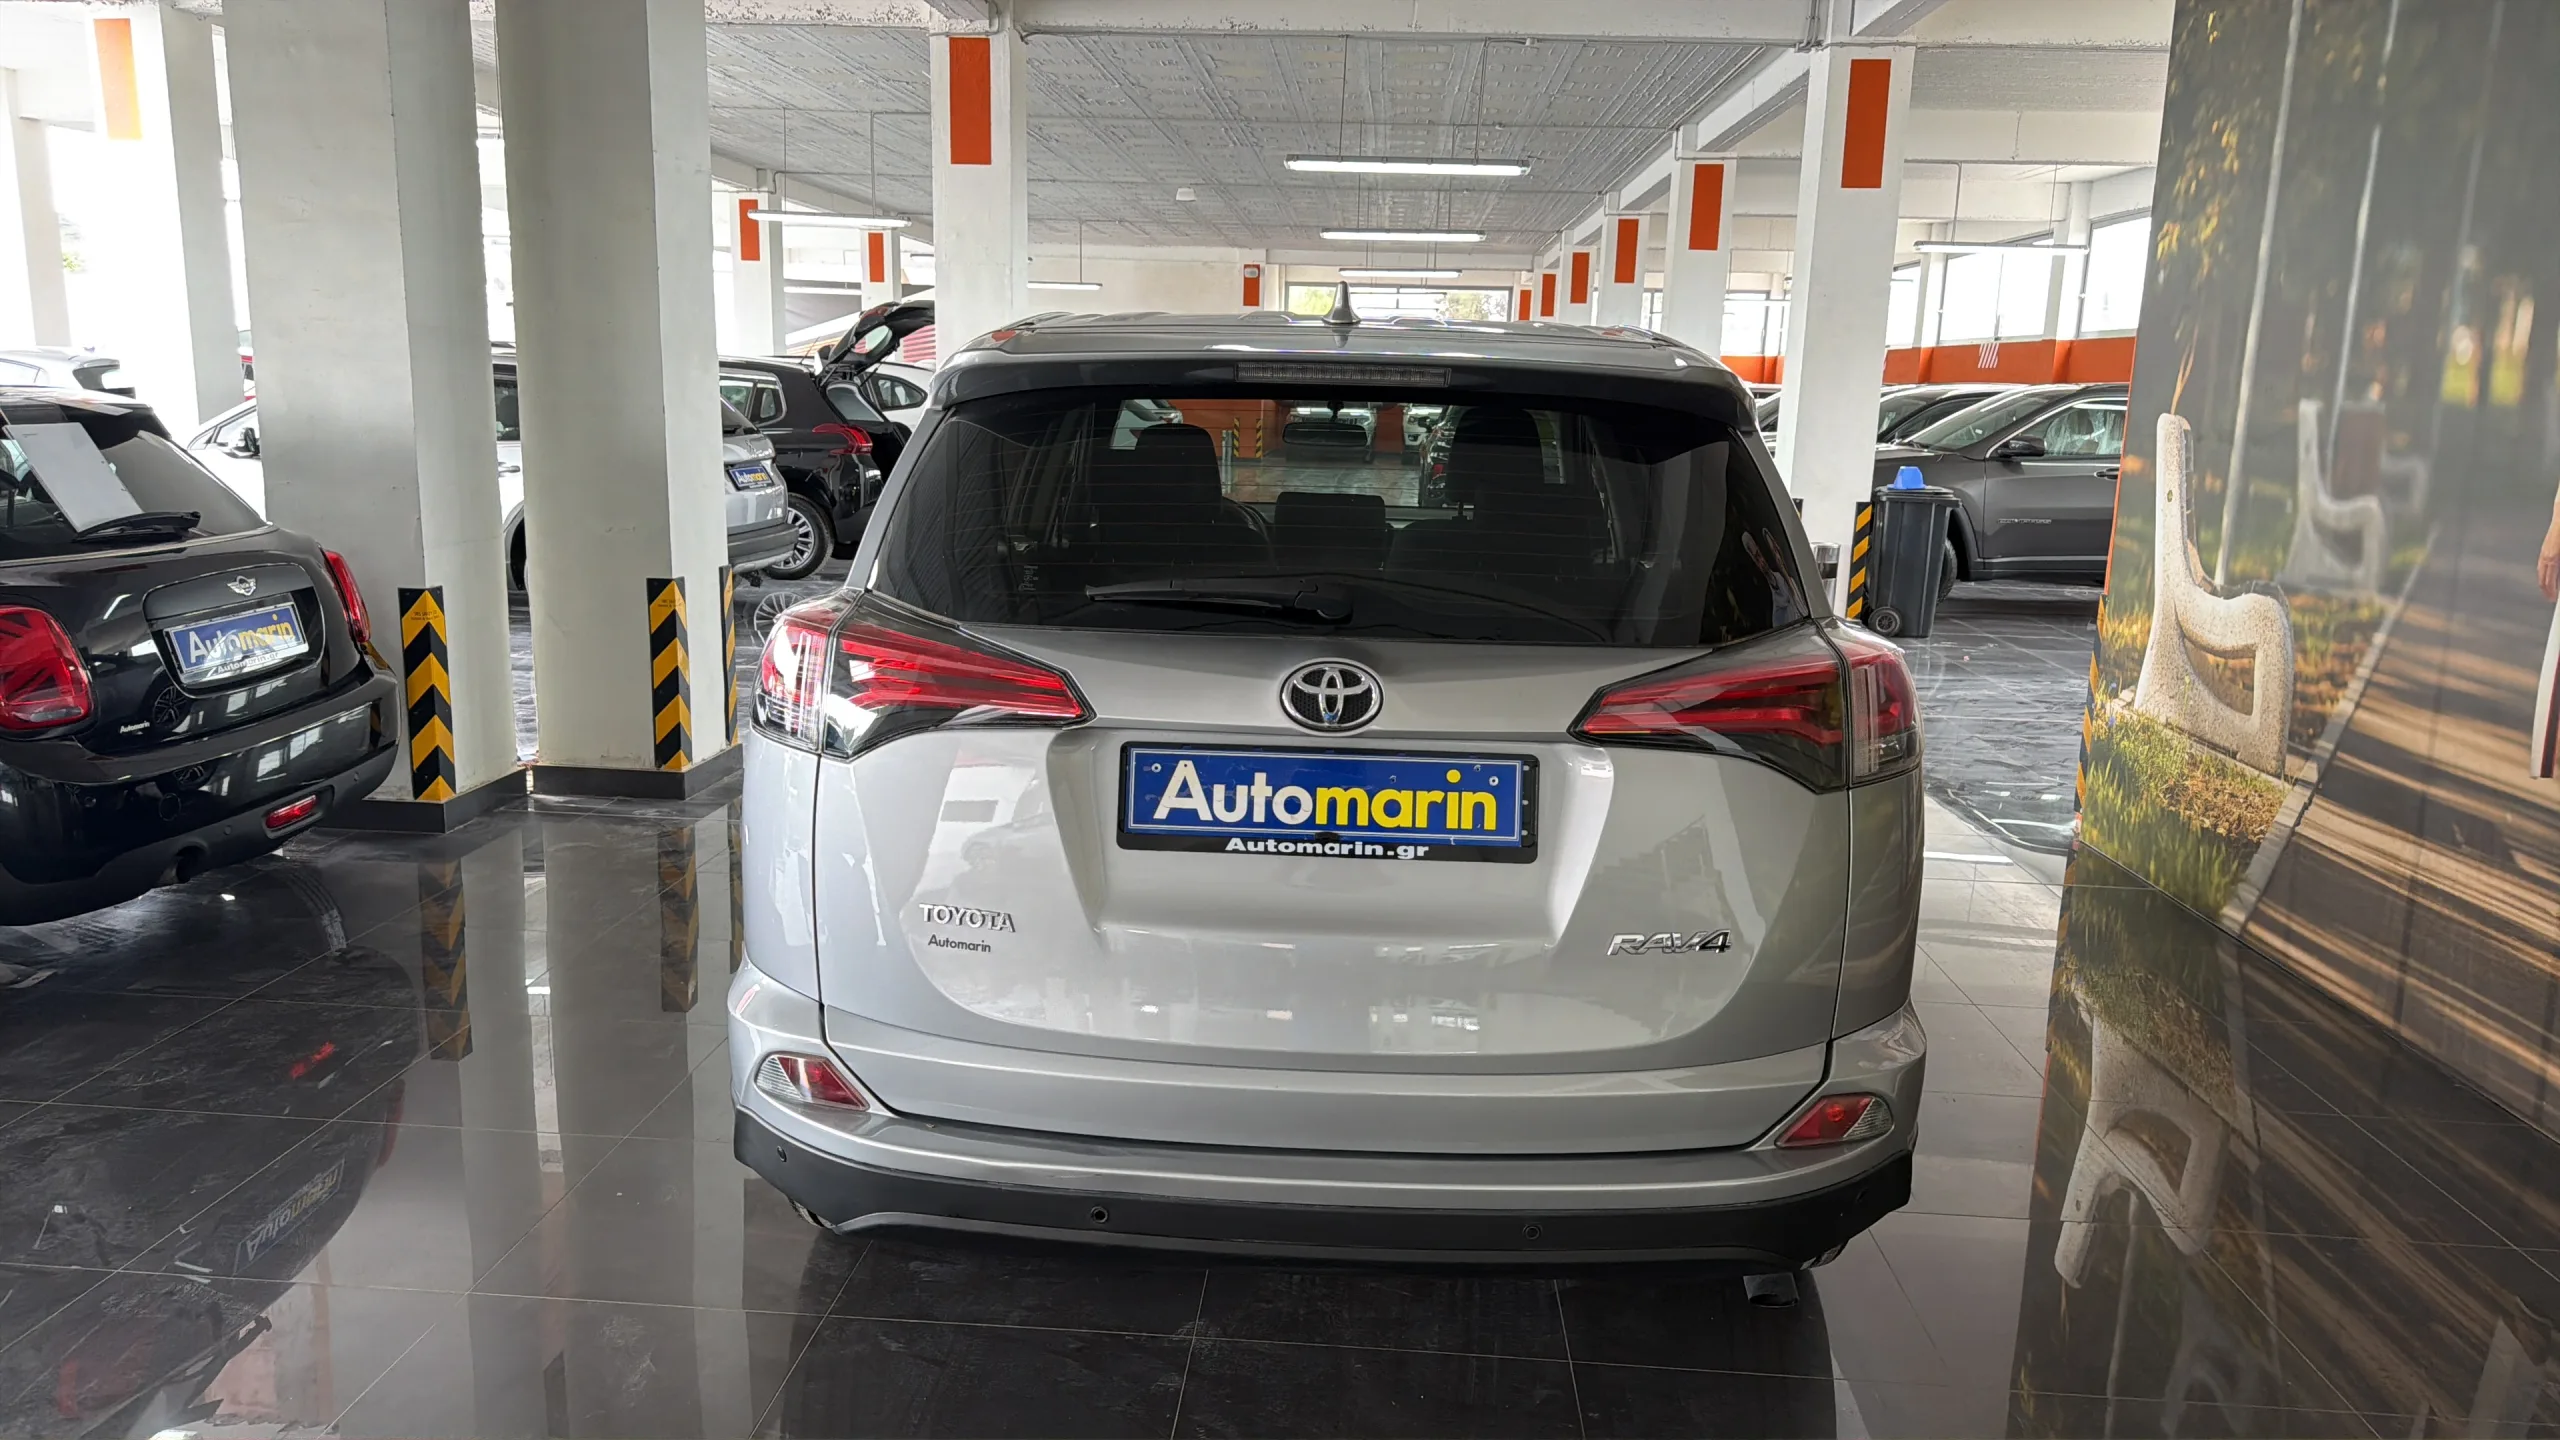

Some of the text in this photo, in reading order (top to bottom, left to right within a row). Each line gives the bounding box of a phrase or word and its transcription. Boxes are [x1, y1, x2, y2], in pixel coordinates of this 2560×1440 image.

[188, 613, 296, 664] Automarin
[217, 651, 280, 674] Automarin.gr
[1153, 760, 1496, 831] Automarin
[1225, 837, 1430, 859] Automarin.gr
[919, 903, 1016, 933] TOYOTA
[928, 934, 991, 953] Automarin
[1606, 929, 1731, 955] RAV4
